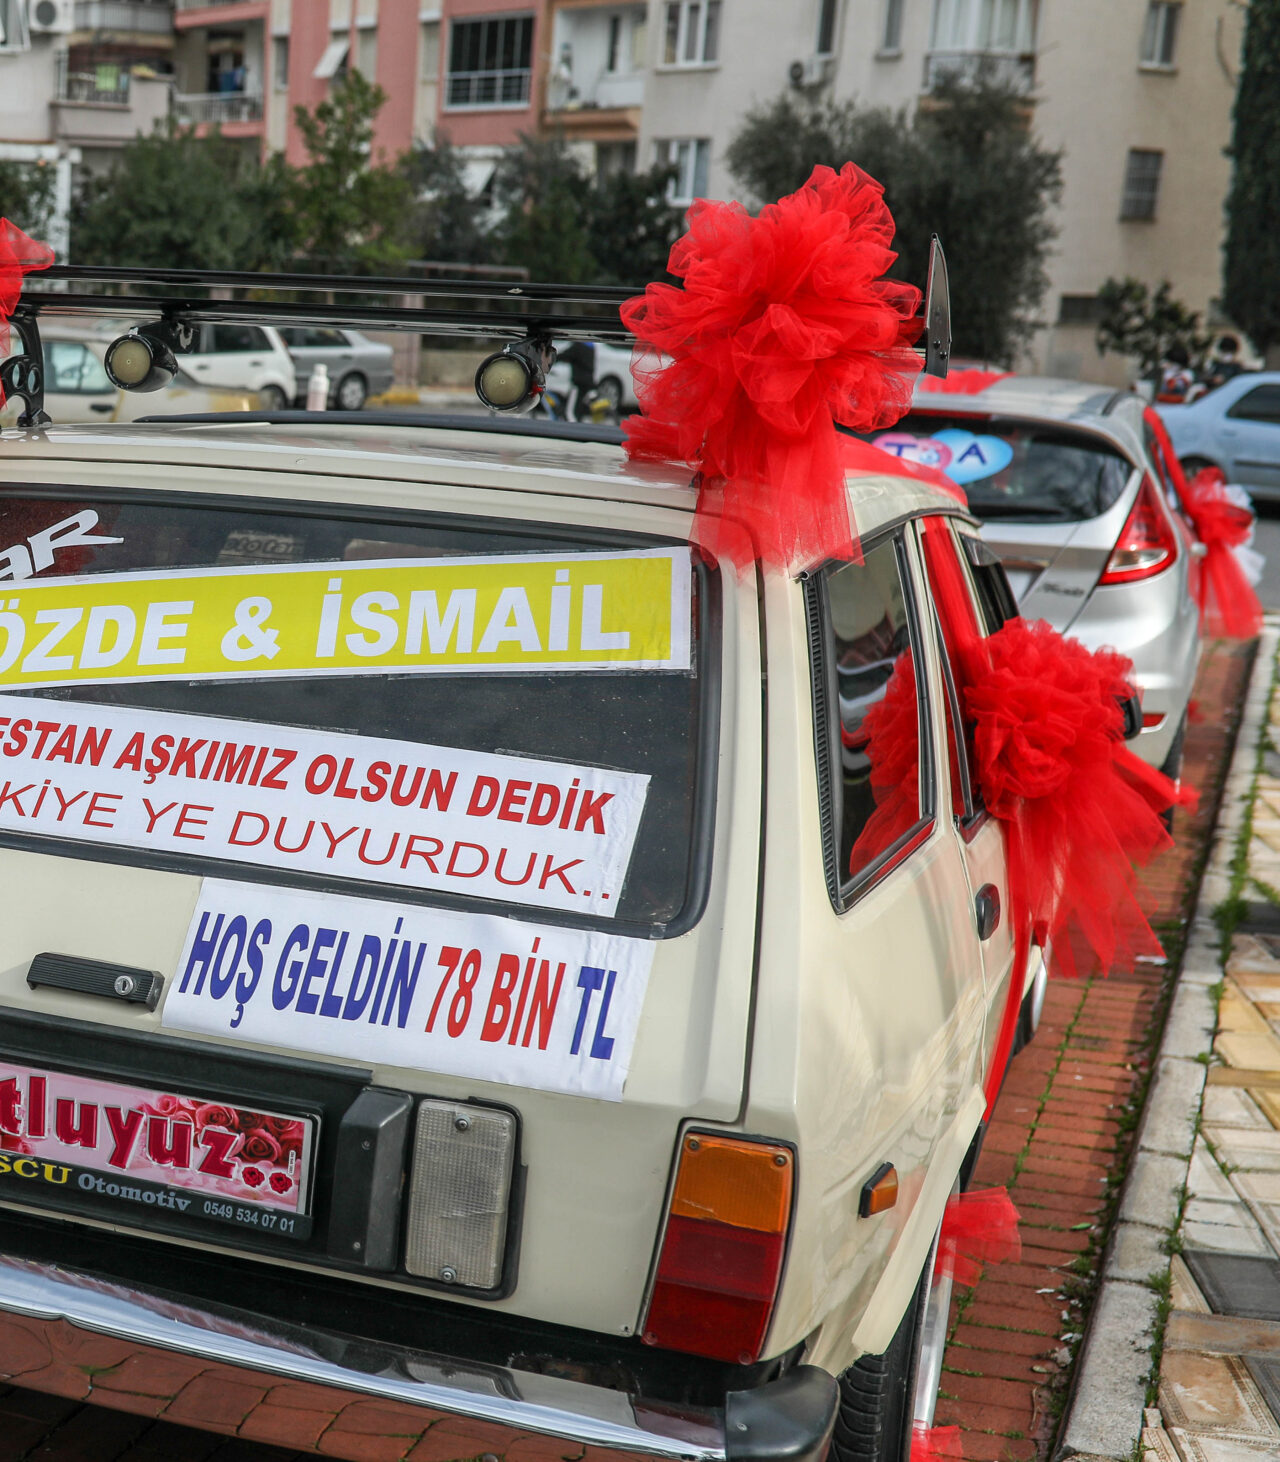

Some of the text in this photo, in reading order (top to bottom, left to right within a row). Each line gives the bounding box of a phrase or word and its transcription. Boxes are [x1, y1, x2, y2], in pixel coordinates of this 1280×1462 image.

[957, 442, 987, 465] A
[220, 595, 282, 661] &
[316, 569, 630, 658] İSMAİL
[114, 732, 298, 790] AŞKIMIZ
[304, 754, 459, 813] OLSUN
[466, 776, 615, 835] DEDİK
[141, 798, 215, 840] YE
[227, 811, 610, 900] DUYURDUK..
[178, 911, 618, 1060] HOŞ GELDİN 78 BİN TL
[78, 1173, 192, 1211] Otomotiv
[203, 1200, 233, 1219] 0549
[236, 1207, 258, 1224] 534
[261, 1212, 277, 1228] 07
[280, 1217, 296, 1233] 01
